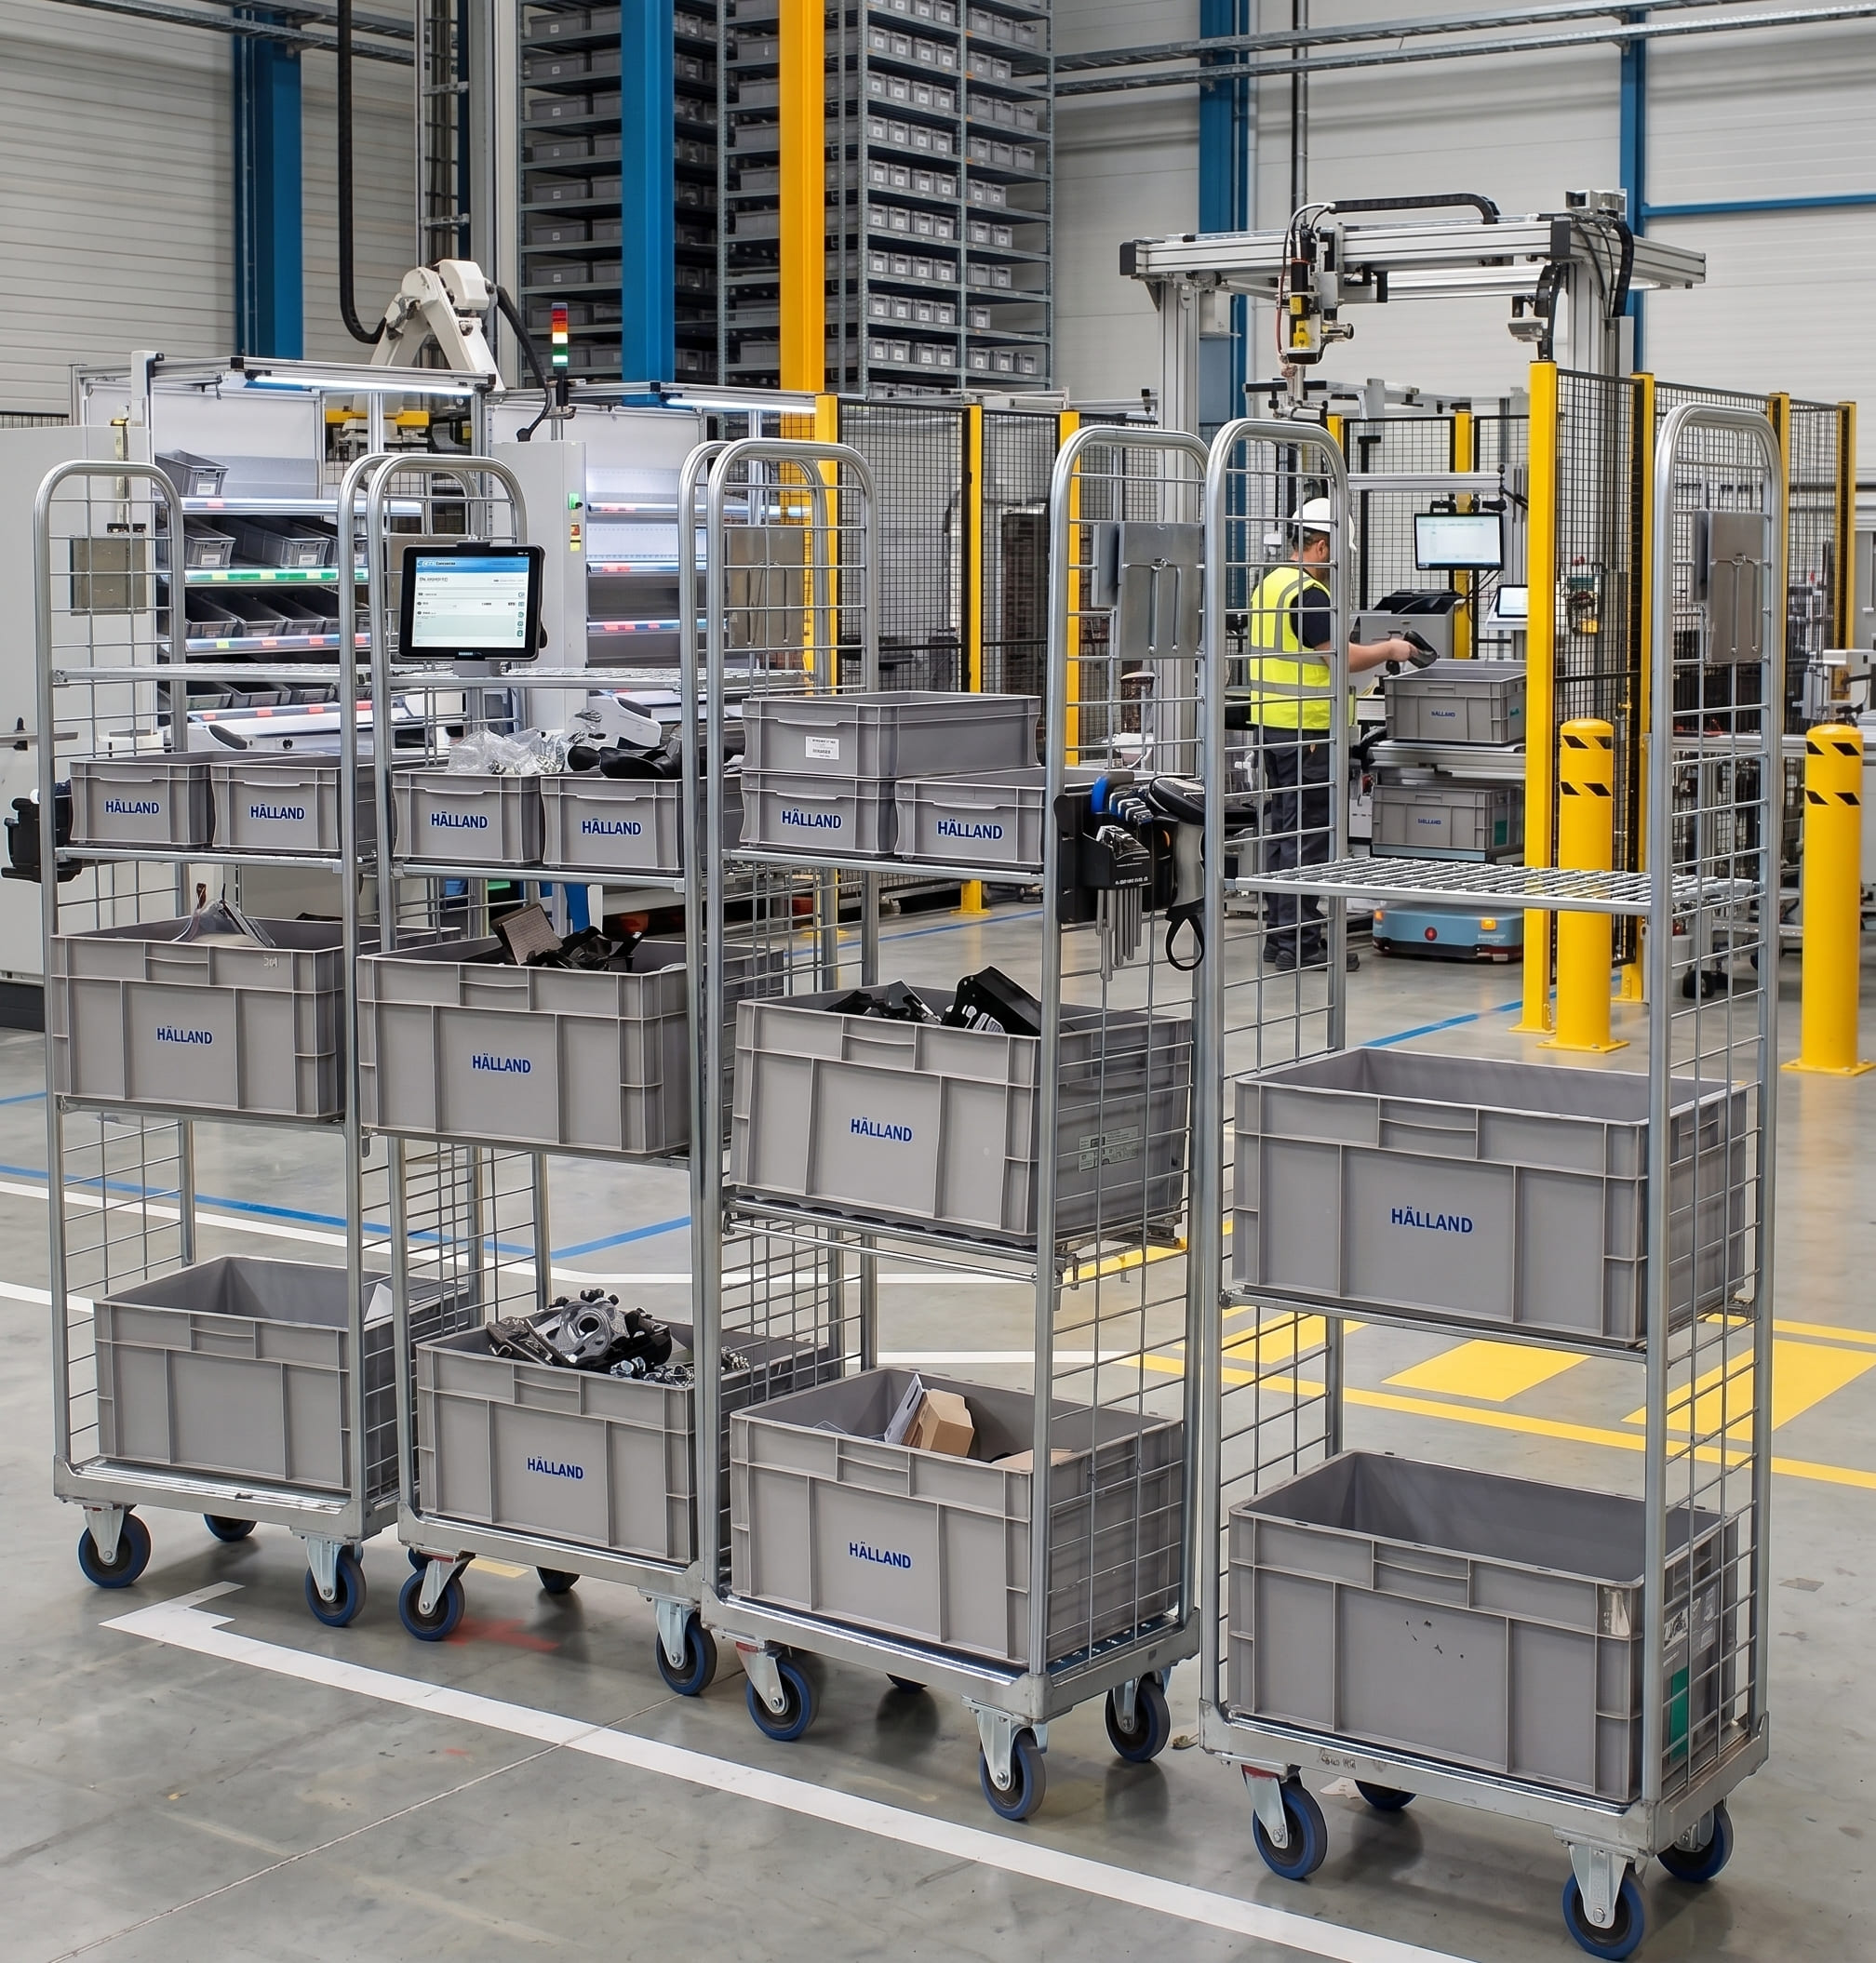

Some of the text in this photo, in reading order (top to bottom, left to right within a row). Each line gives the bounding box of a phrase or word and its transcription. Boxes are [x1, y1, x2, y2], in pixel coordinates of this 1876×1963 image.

[937, 818, 1003, 840] HÄLLAND
[156, 1025, 213, 1044] HÄLLAND
[472, 1052, 531, 1074] HÄLLAND
[851, 1116, 913, 1142] HÄLLAND
[1391, 1205, 1473, 1234] HÄLLAND
[527, 1455, 584, 1480] HÄLLAND
[849, 1541, 912, 1569] HÄLLAND
